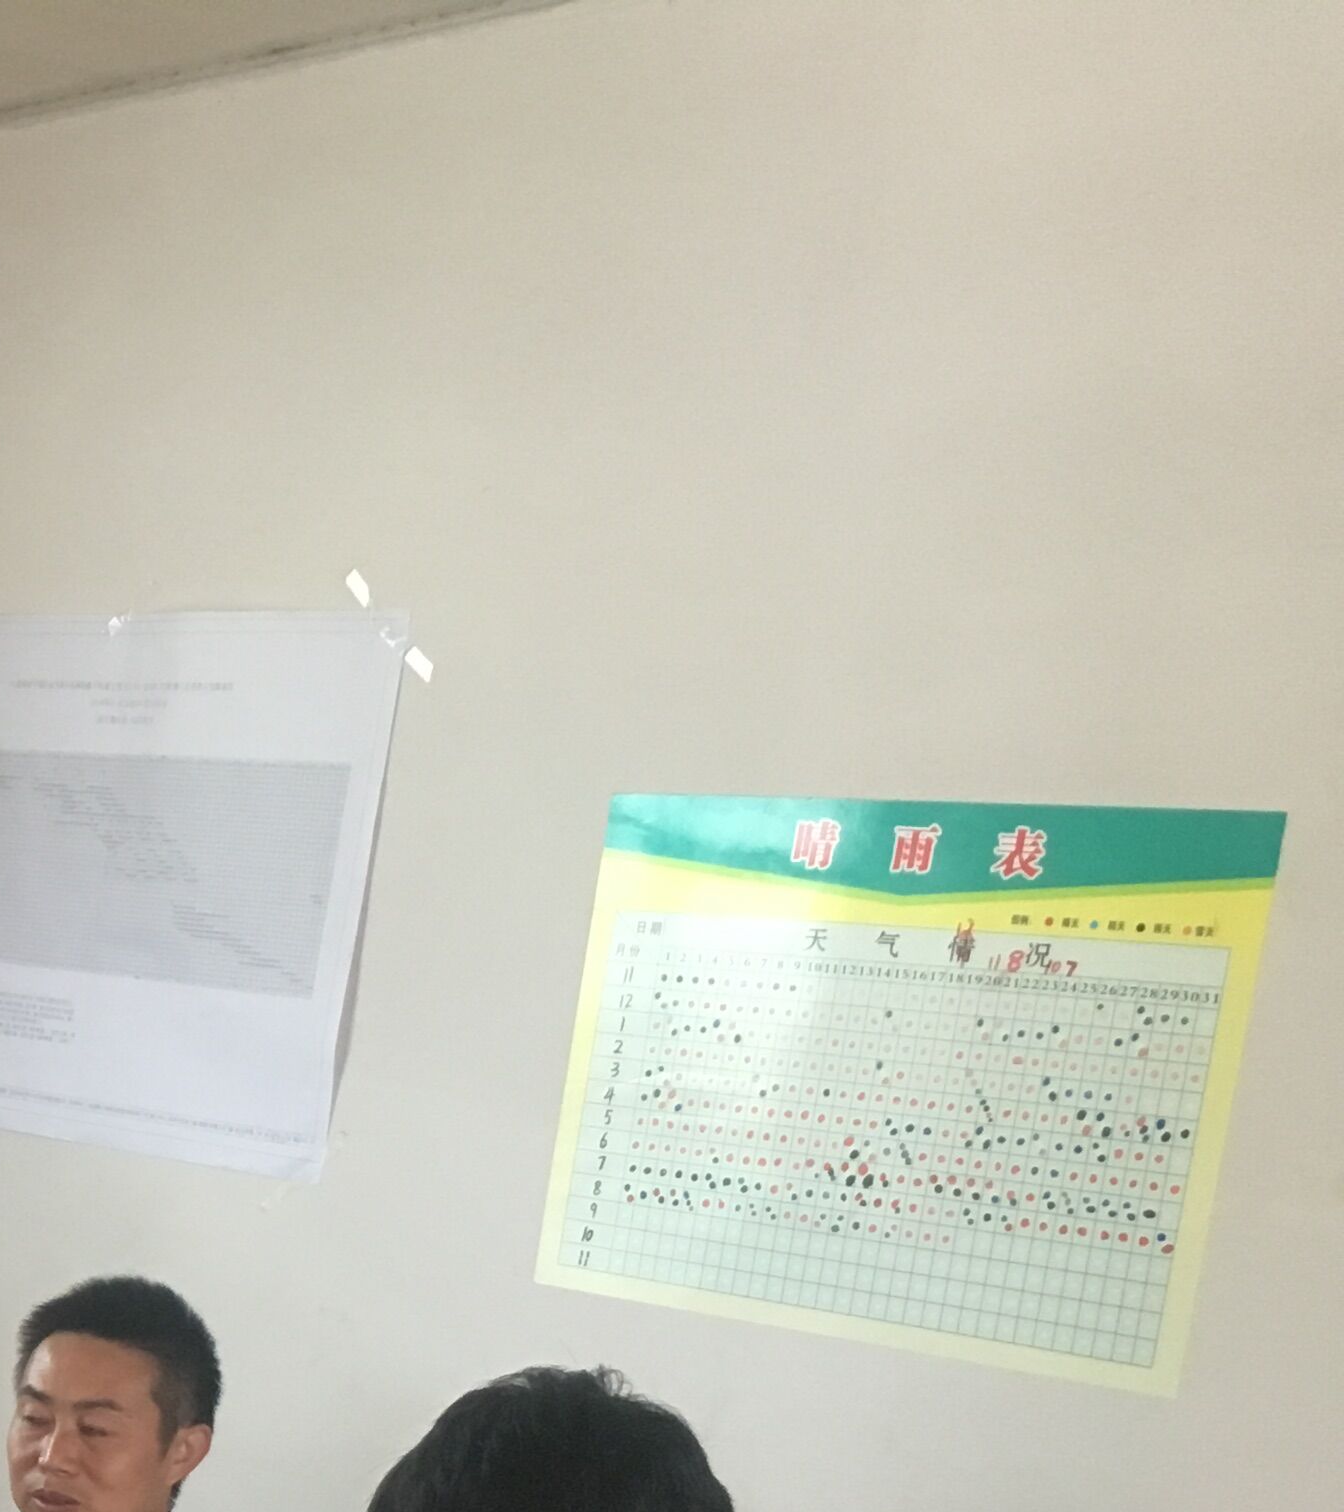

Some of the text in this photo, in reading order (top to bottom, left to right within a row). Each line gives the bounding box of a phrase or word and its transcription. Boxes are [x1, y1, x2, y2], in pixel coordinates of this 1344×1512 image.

[791, 817, 1047, 880] 晴雨表
[636, 921, 663, 936] 日期
[616, 943, 641, 957] 月份
[623, 965, 634, 984] 11
[1066, 960, 1078, 977] 7
[825, 963, 838, 974] 11
[877, 967, 890, 977] 14
[1022, 979, 1038, 989] 22
[1100, 984, 1118, 995] 26
[1120, 985, 1138, 997] 27
[619, 993, 633, 1008] 12
[613, 1040, 624, 1054] 2
[611, 1062, 620, 1077] 3
[603, 1086, 615, 1105] 4
[604, 1109, 613, 1125] 5
[599, 1132, 608, 1149] 6
[598, 1155, 607, 1170] 7
[593, 1180, 602, 1196] 8
[590, 1202, 598, 1219] 9
[581, 1226, 594, 1242] 10
[578, 1250, 590, 1266] 11
